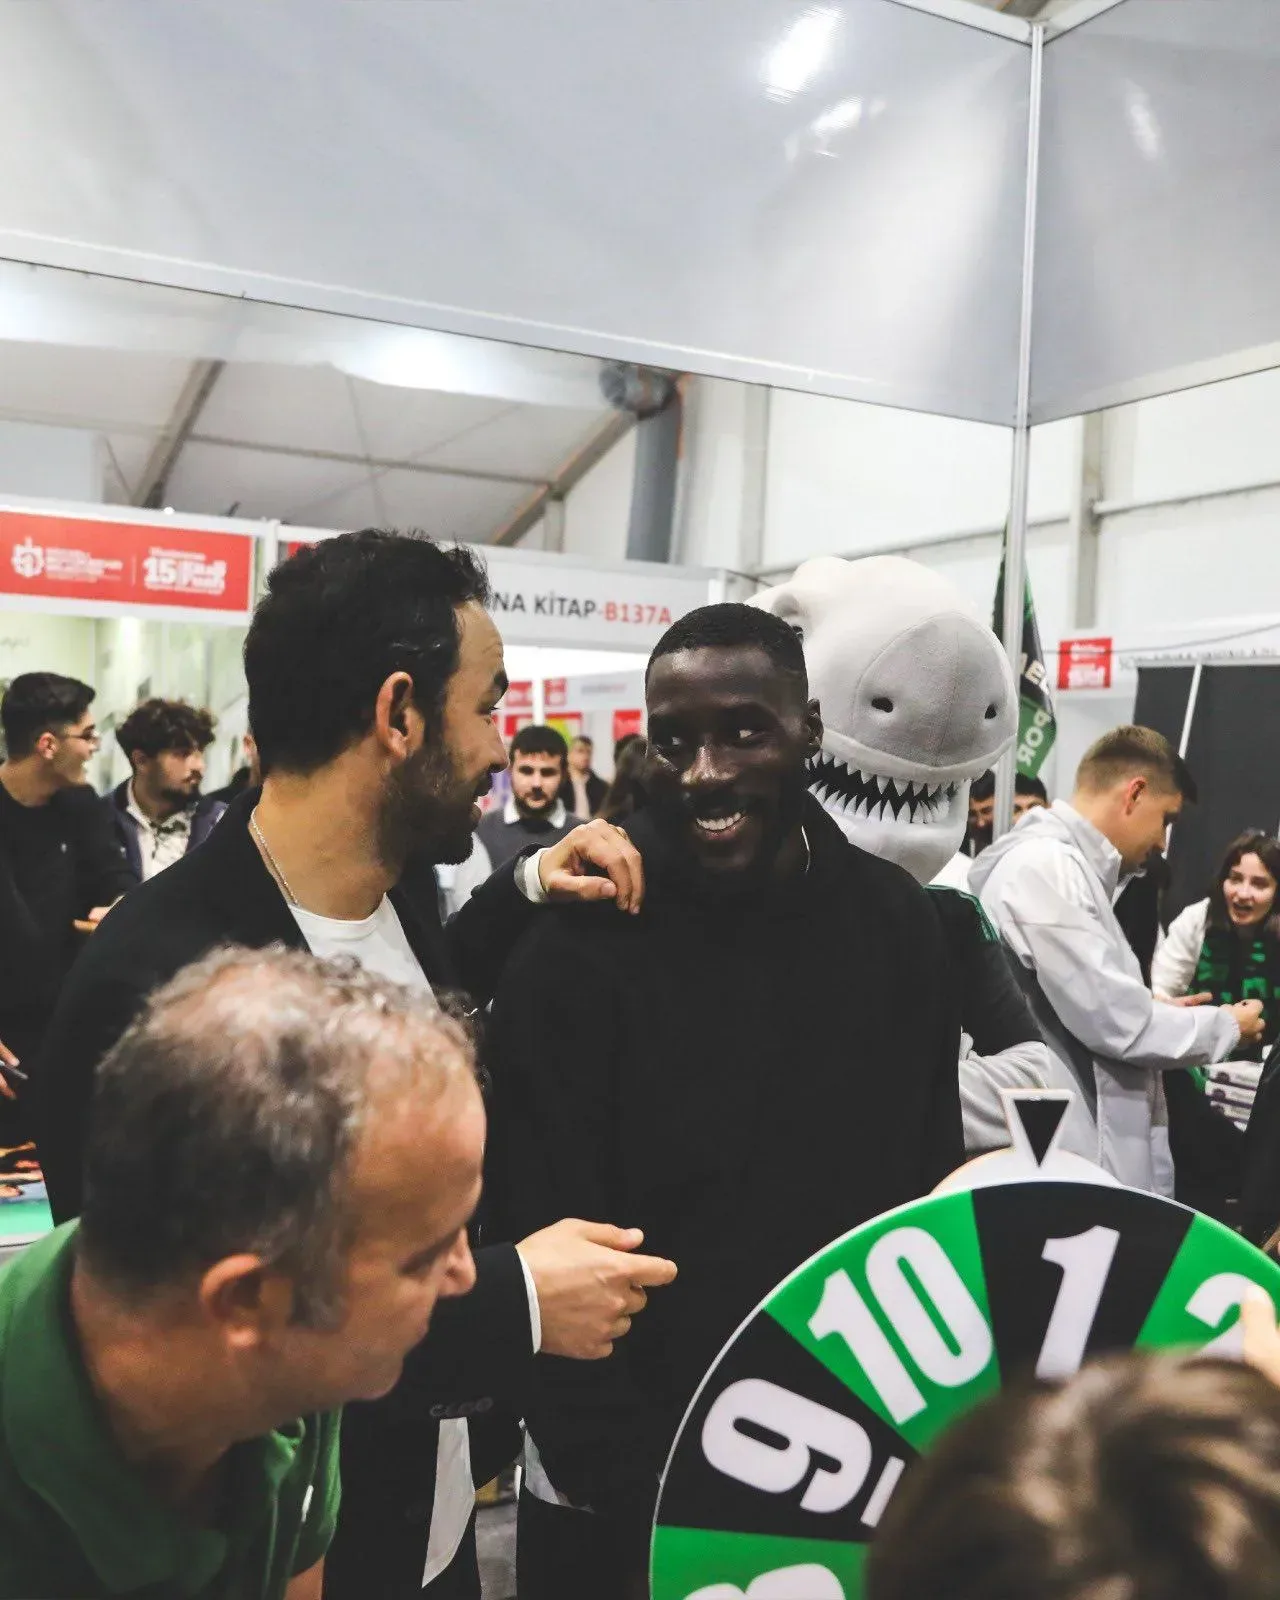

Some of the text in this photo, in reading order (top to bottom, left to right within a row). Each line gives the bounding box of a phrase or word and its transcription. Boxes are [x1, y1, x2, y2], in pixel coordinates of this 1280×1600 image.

[807, 1226, 994, 1426] 10
[1035, 1225, 1121, 1381] 1
[701, 1378, 872, 1513] 9
